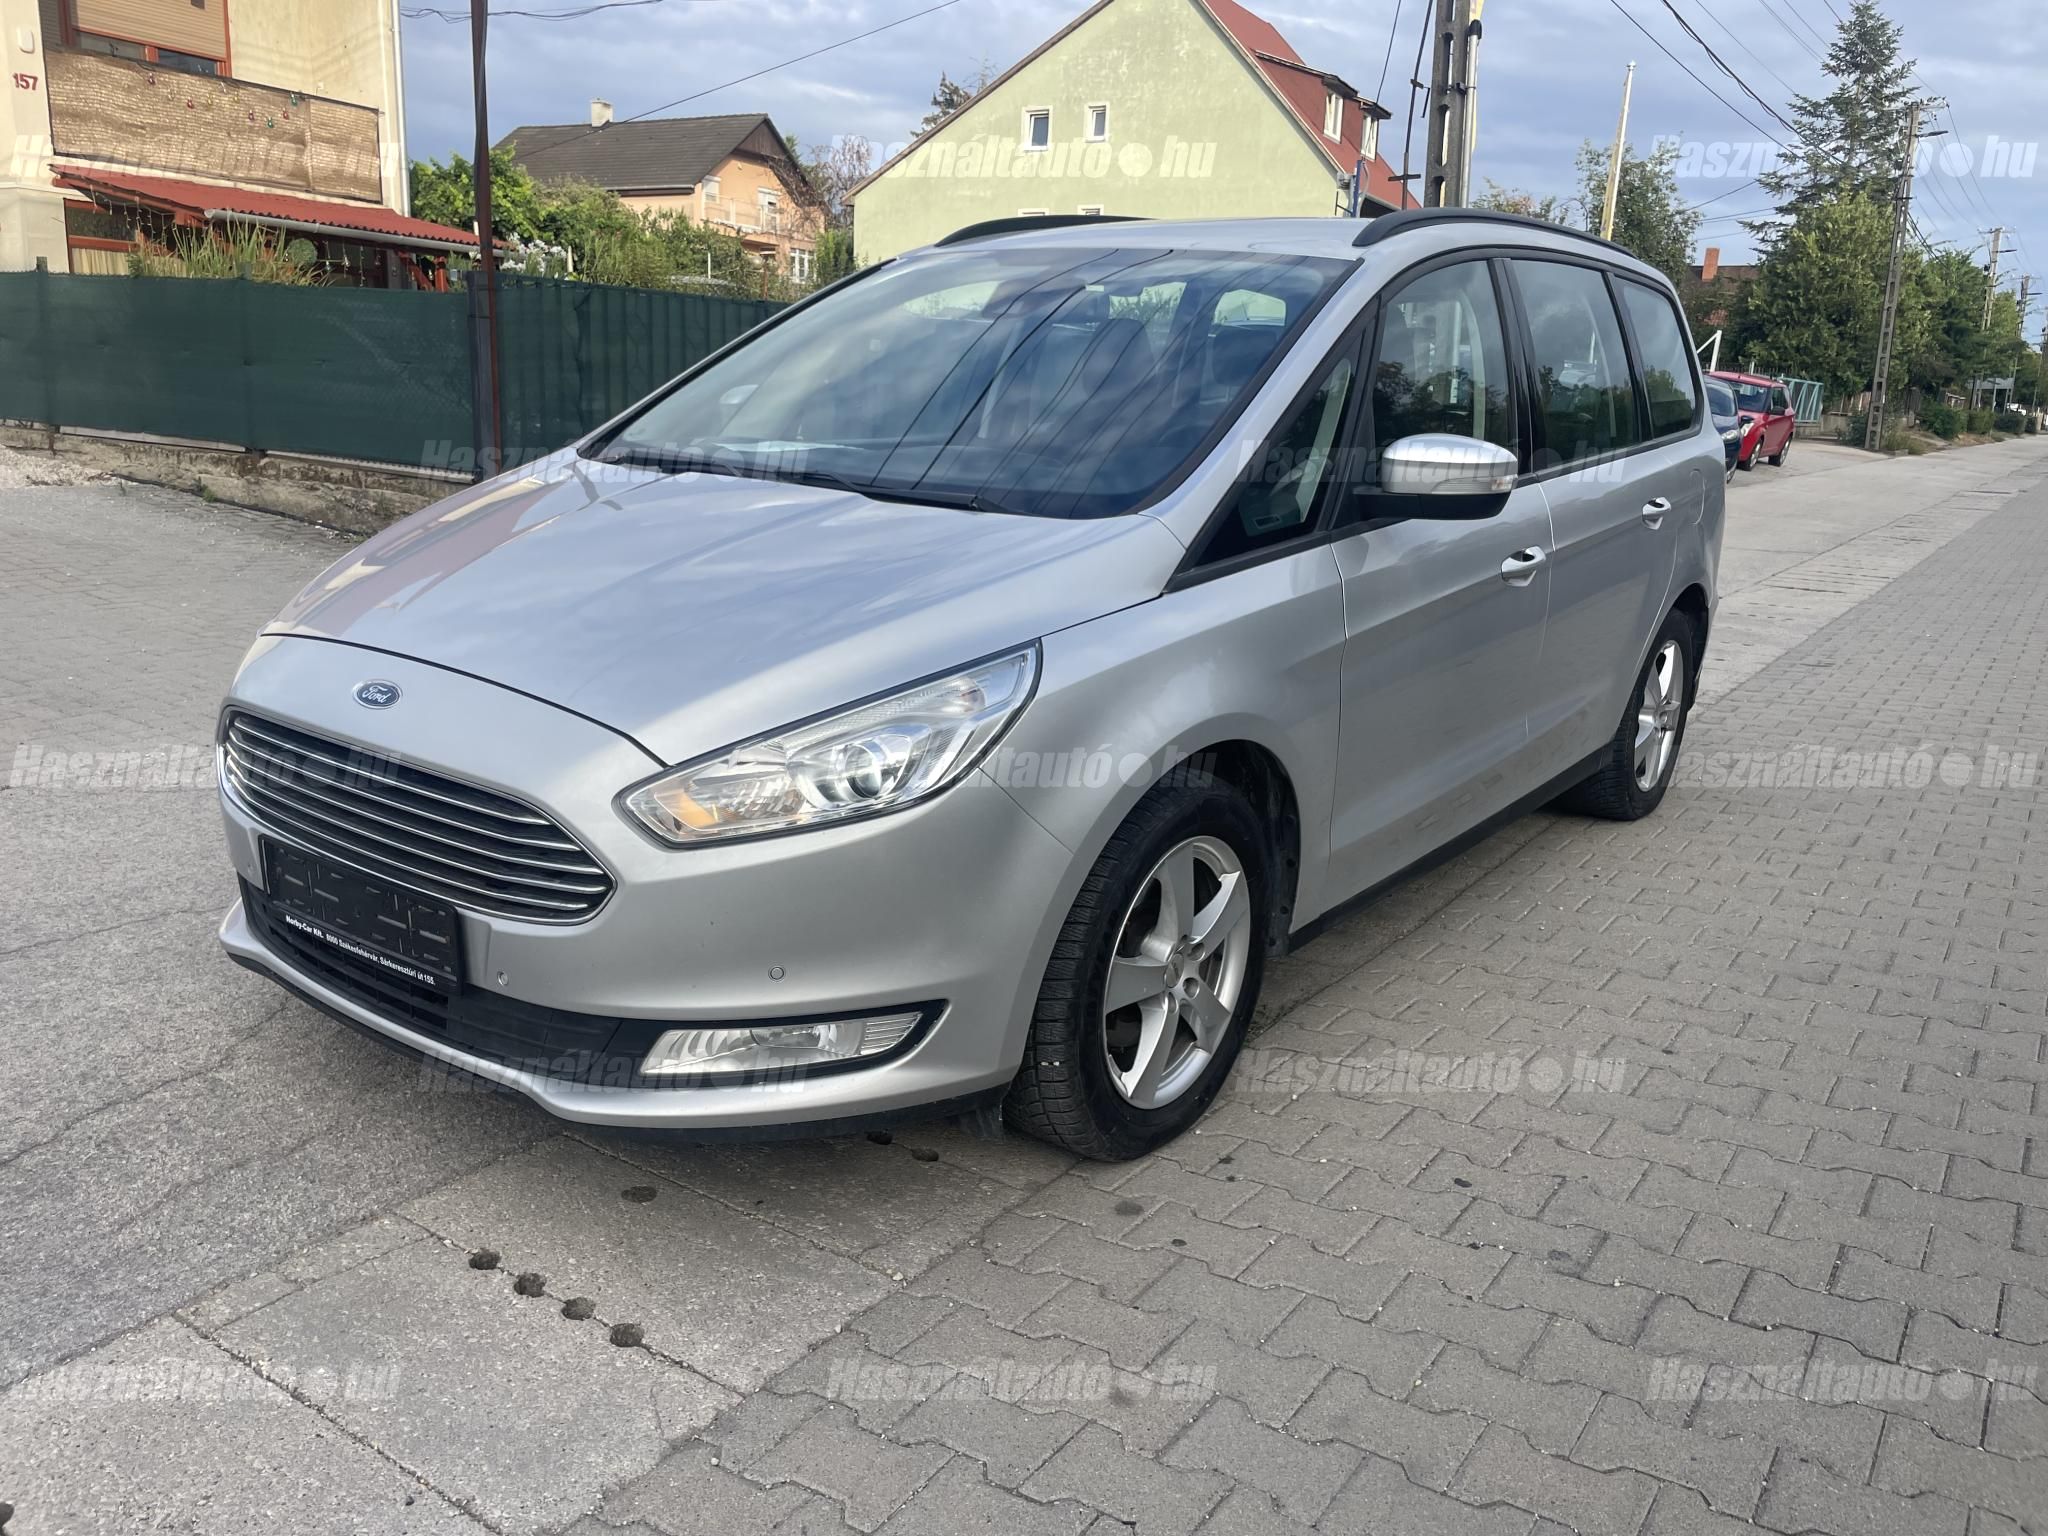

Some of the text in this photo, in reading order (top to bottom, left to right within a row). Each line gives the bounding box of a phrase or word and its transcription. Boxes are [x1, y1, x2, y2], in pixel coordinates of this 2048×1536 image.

[12, 72, 38, 91] 157
[361, 684, 392, 703] Ford
[285, 914, 313, 934] Norby-Car
